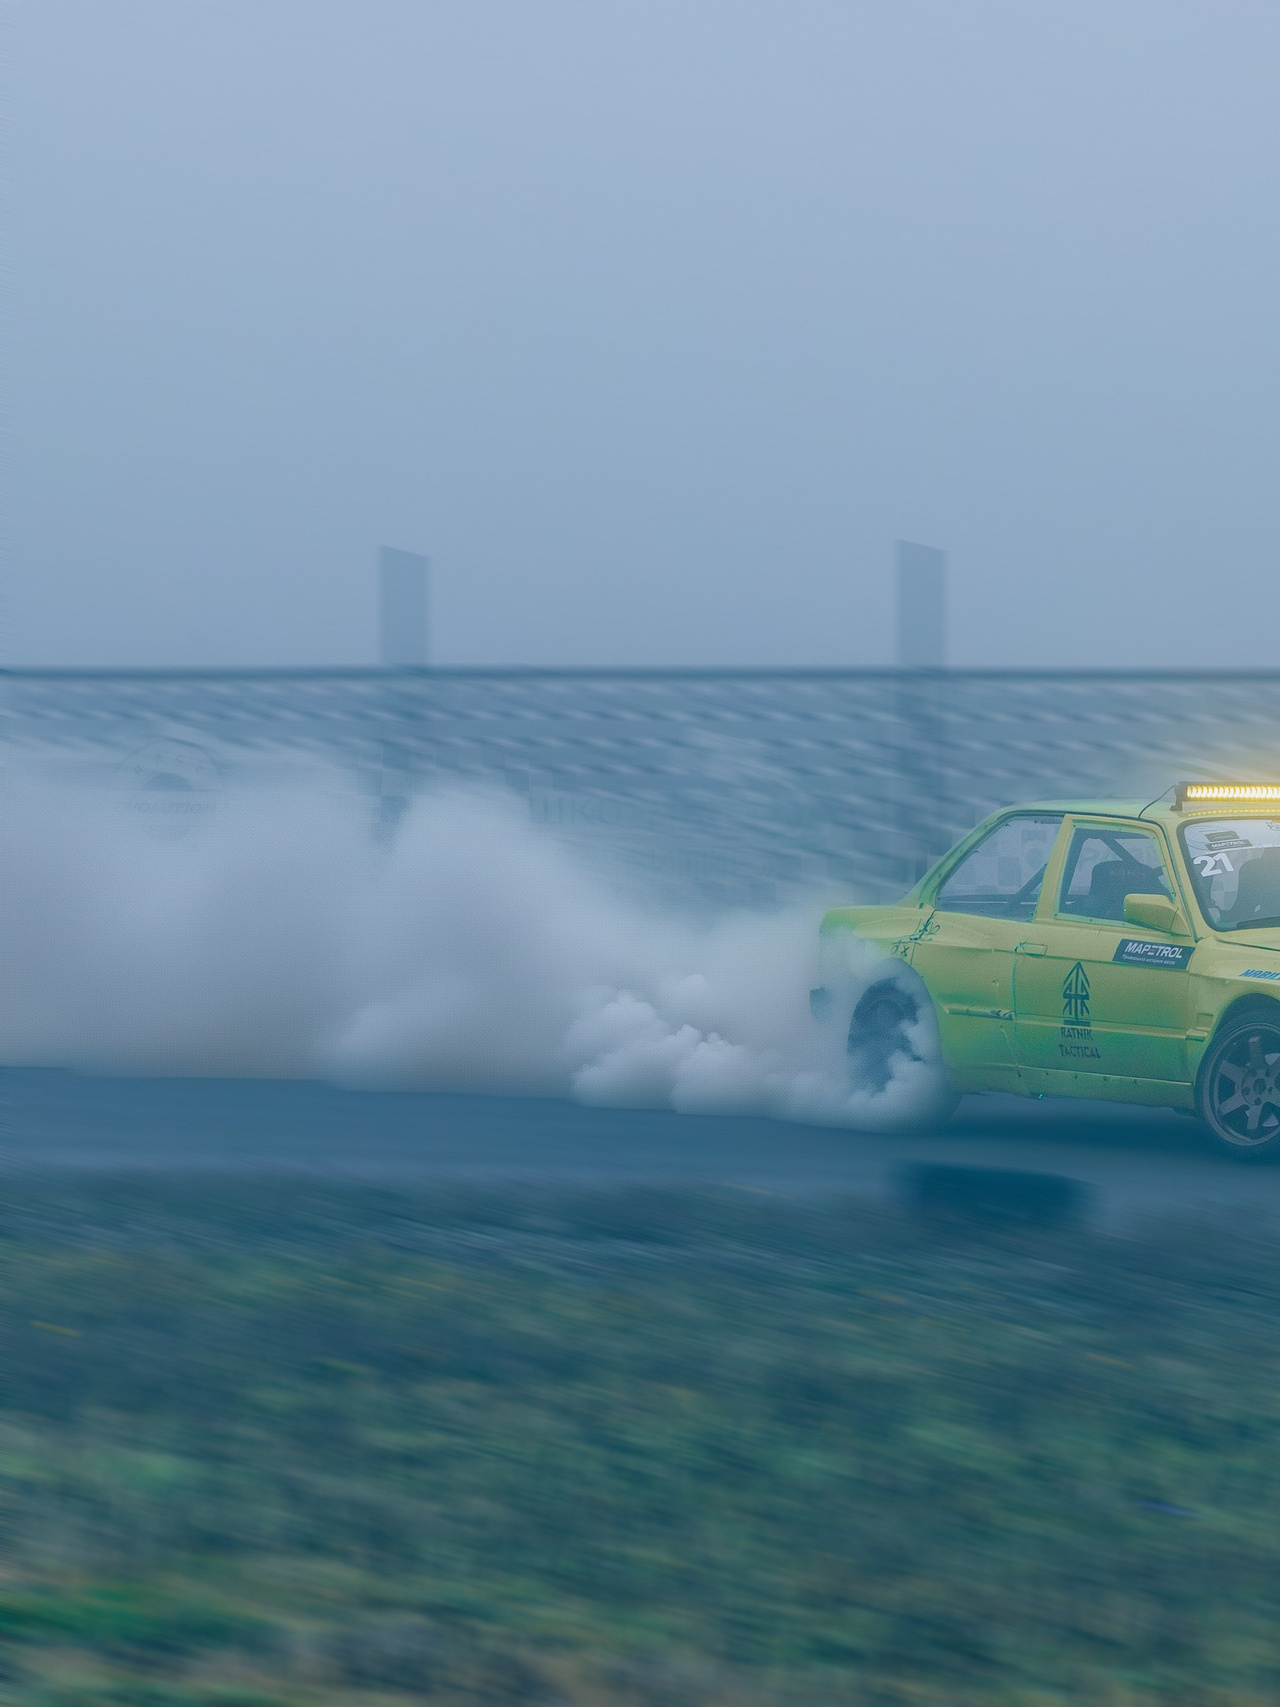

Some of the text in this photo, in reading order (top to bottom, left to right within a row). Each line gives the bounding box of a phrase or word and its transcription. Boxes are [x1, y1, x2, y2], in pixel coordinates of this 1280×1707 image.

[1193, 852, 1234, 877] 21
[1124, 941, 1183, 959] MAPETROL
[1060, 1027, 1094, 1040] RATNIK
[1058, 1044, 1102, 1059] TACTICAL
